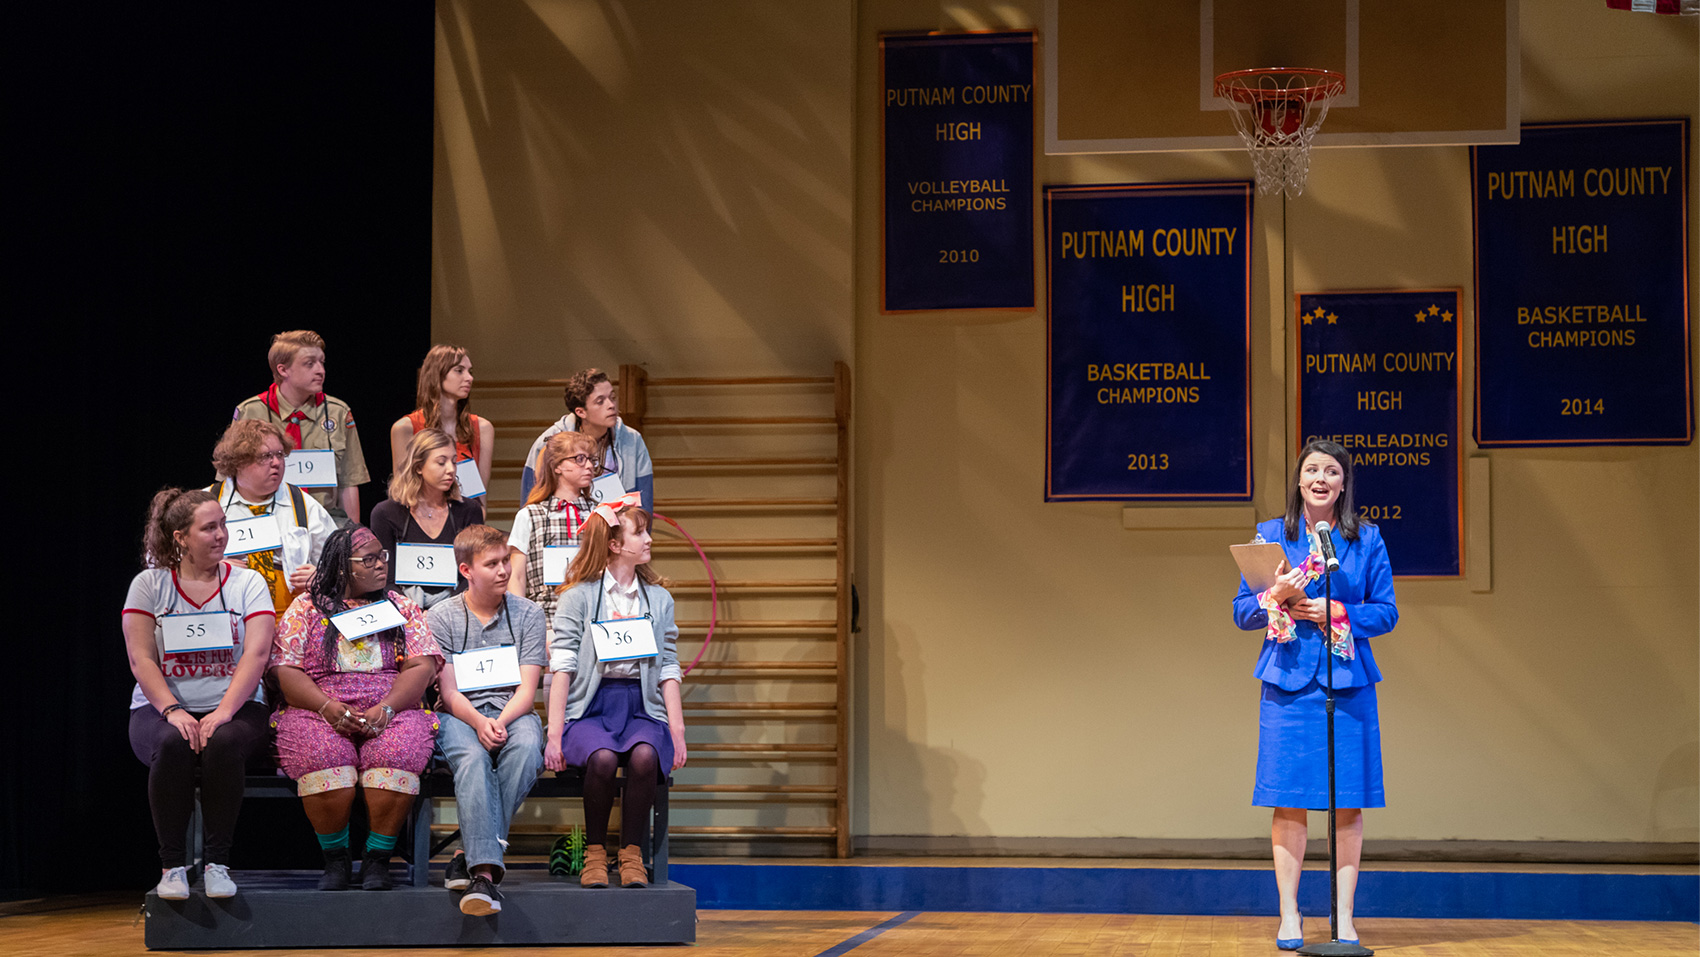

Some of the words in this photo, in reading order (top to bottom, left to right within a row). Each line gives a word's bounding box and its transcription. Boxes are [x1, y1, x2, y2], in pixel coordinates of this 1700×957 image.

[887, 87, 955, 107] PUTNAM
[962, 84, 1031, 105] COUNTY
[936, 122, 981, 141] HIGH
[908, 179, 1010, 195] VOLLEYBALL
[1488, 169, 1575, 200] PUTNAM
[1583, 166, 1672, 197] COUNTY
[911, 197, 1007, 213] CHAMPIONS
[1062, 229, 1144, 259] PUTNAM
[1152, 227, 1237, 257] COUNTY
[1552, 225, 1608, 254] HIGH
[939, 249, 980, 263] 2010
[1122, 284, 1175, 312] HIGH
[1517, 305, 1647, 325] BASKETBALL
[1528, 329, 1636, 348] CHAMPIONS
[1306, 353, 1376, 374] PUTNAM
[1383, 352, 1455, 373] COUNTY
[1087, 362, 1211, 382] BASKETBALL
[1097, 386, 1200, 404] CHAMPIONS
[1357, 390, 1402, 411] HIGH
[1561, 398, 1605, 416] 2014
[1127, 453, 1169, 470] 2013
[1350, 452, 1431, 466] AMPIONS
[1359, 505, 1402, 520] 2012
[236, 527, 254, 541] 21
[416, 555, 434, 570] 83
[356, 613, 378, 627] 32
[186, 623, 206, 638] 55
[614, 631, 633, 646] 36
[161, 663, 238, 678] LOVERS
[475, 659, 495, 674] 47
